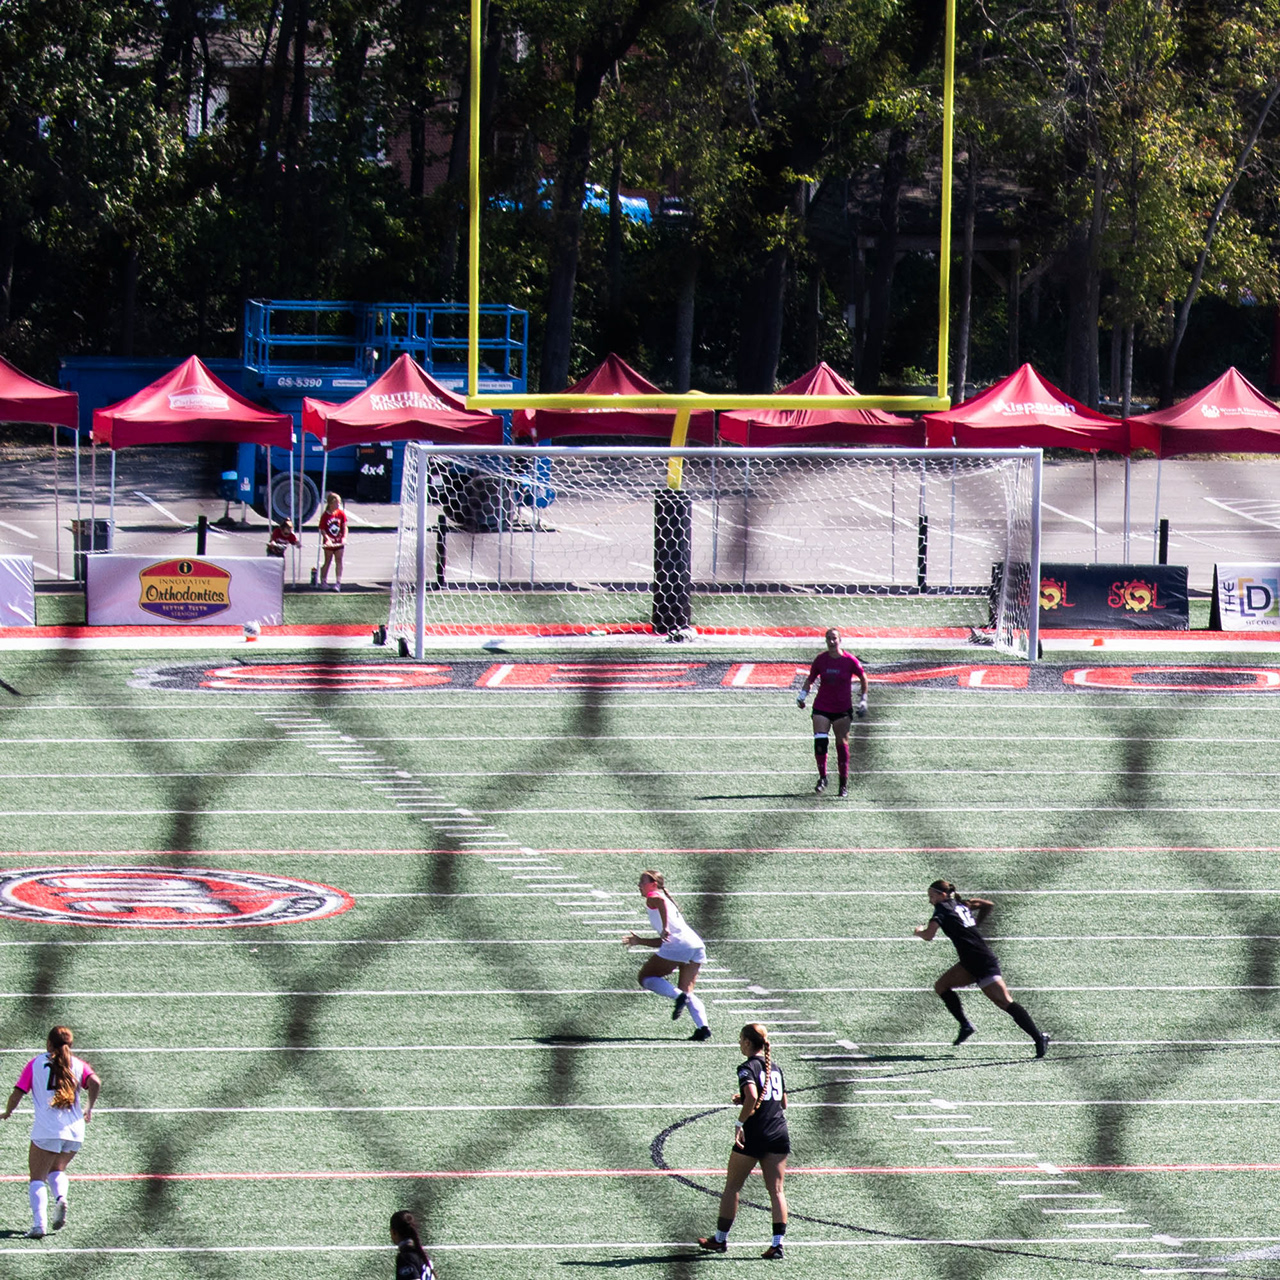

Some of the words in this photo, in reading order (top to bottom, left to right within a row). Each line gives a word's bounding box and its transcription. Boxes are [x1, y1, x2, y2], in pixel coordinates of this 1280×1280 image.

[277, 377, 322, 388] GS-5390
[361, 464, 385, 475] 4x4
[159, 578, 211, 586] INNOVATIVE
[146, 585, 225, 602] Orthodontics
